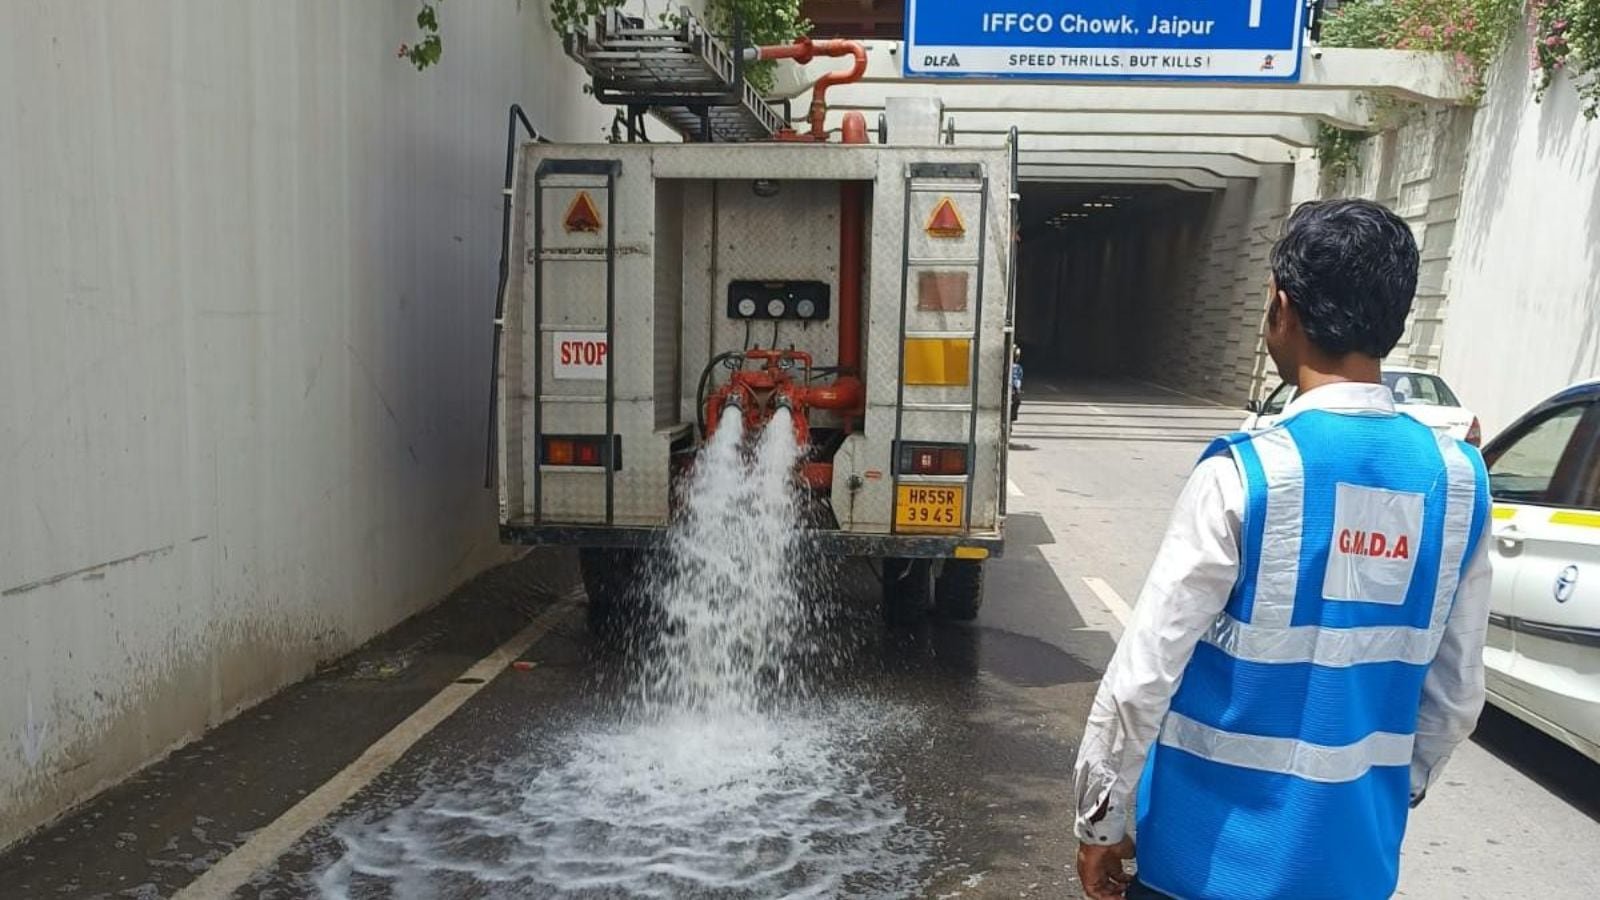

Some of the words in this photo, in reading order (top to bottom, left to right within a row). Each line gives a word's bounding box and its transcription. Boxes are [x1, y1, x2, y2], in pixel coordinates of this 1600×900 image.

[983, 13, 1053, 33] IFFCO
[1060, 13, 1139, 35] Chowk,
[1147, 14, 1215, 37] Jaipur
[924, 55, 949, 67] DLF
[1008, 54, 1056, 66] SPEED
[1060, 55, 1124, 68] THRILLS,
[1130, 55, 1158, 67] BUT
[1162, 56, 1202, 68] KILLS
[561, 341, 608, 366] STOP
[909, 488, 955, 505] HR55R
[908, 507, 953, 523] 3945
